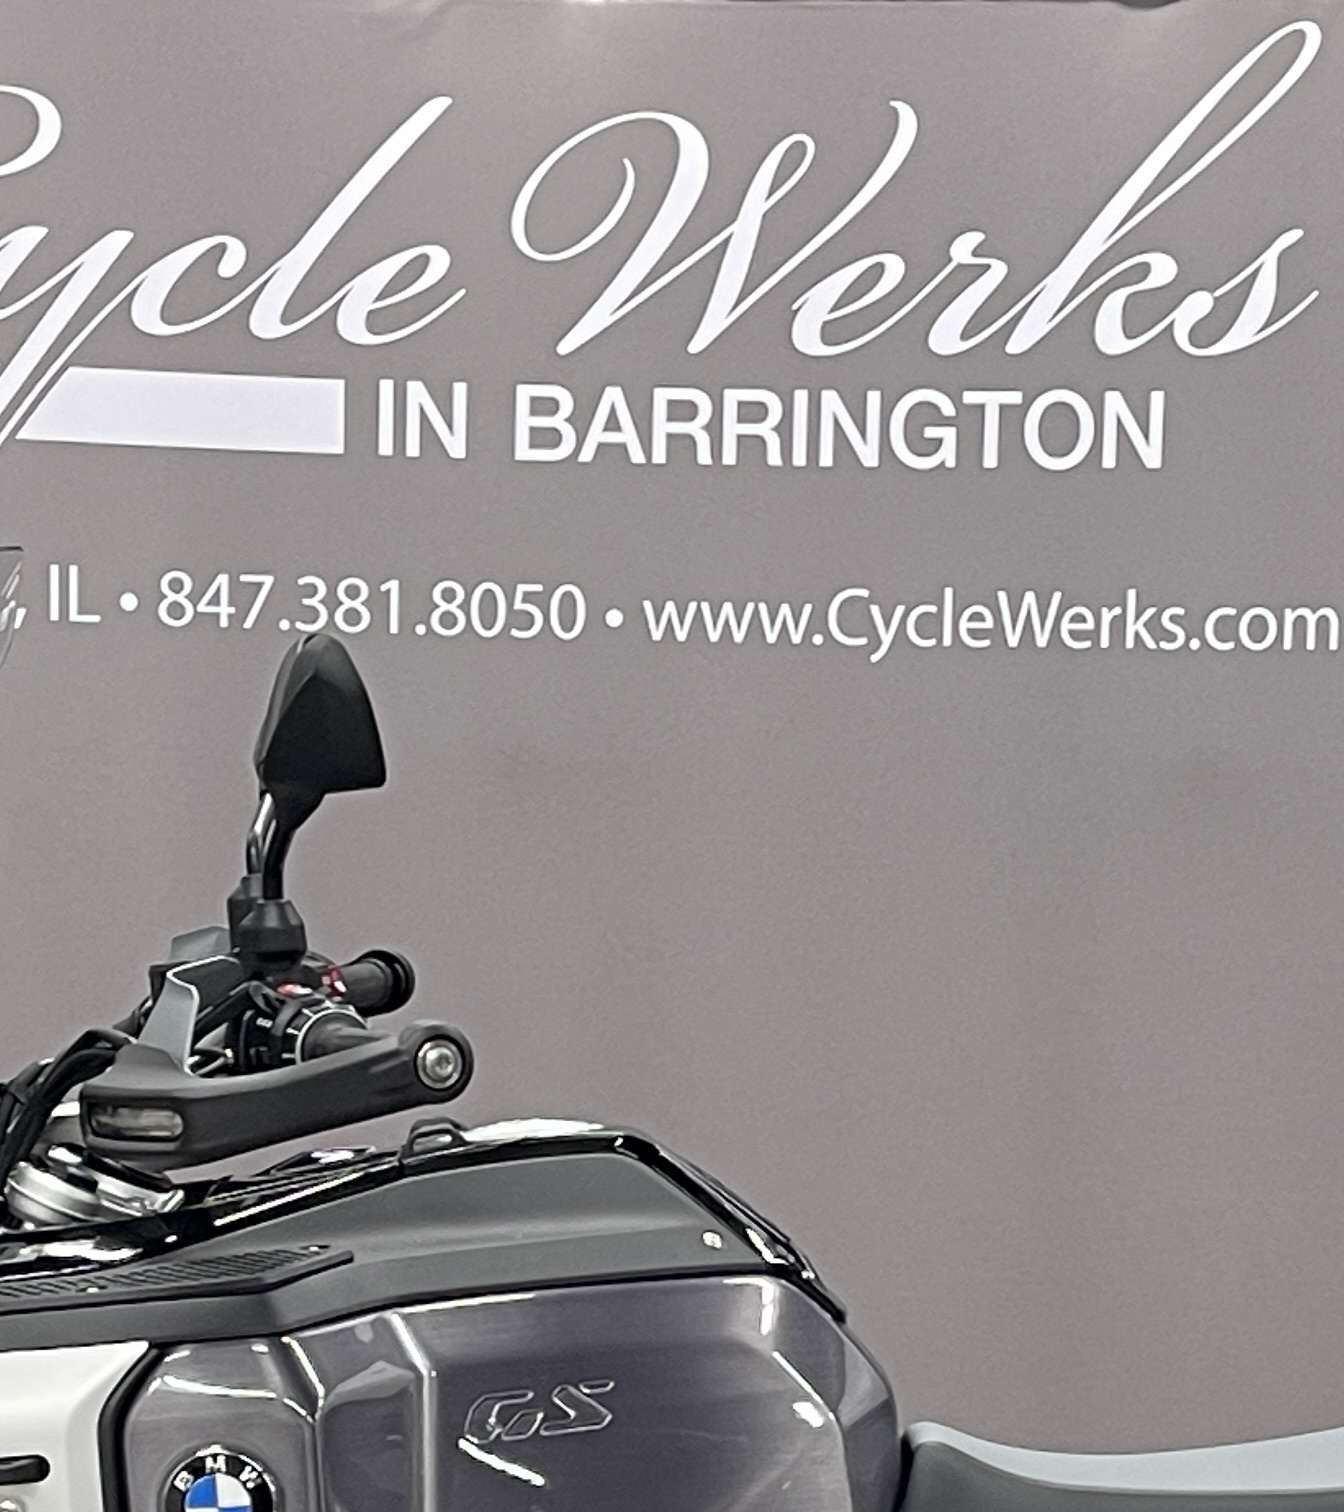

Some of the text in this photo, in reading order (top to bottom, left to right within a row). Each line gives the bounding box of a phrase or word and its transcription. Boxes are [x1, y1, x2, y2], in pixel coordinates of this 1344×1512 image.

[510, 19, 1323, 357] Werks
[377, 379, 1166, 472] IN BARRINGTON
[48, 563, 102, 624] IL
[157, 569, 587, 641] 847.381.8050
[641, 586, 1340, 664] www.CycleWerks.com
[463, 1379, 616, 1445] GS
[172, 1454, 262, 1492] BMW
